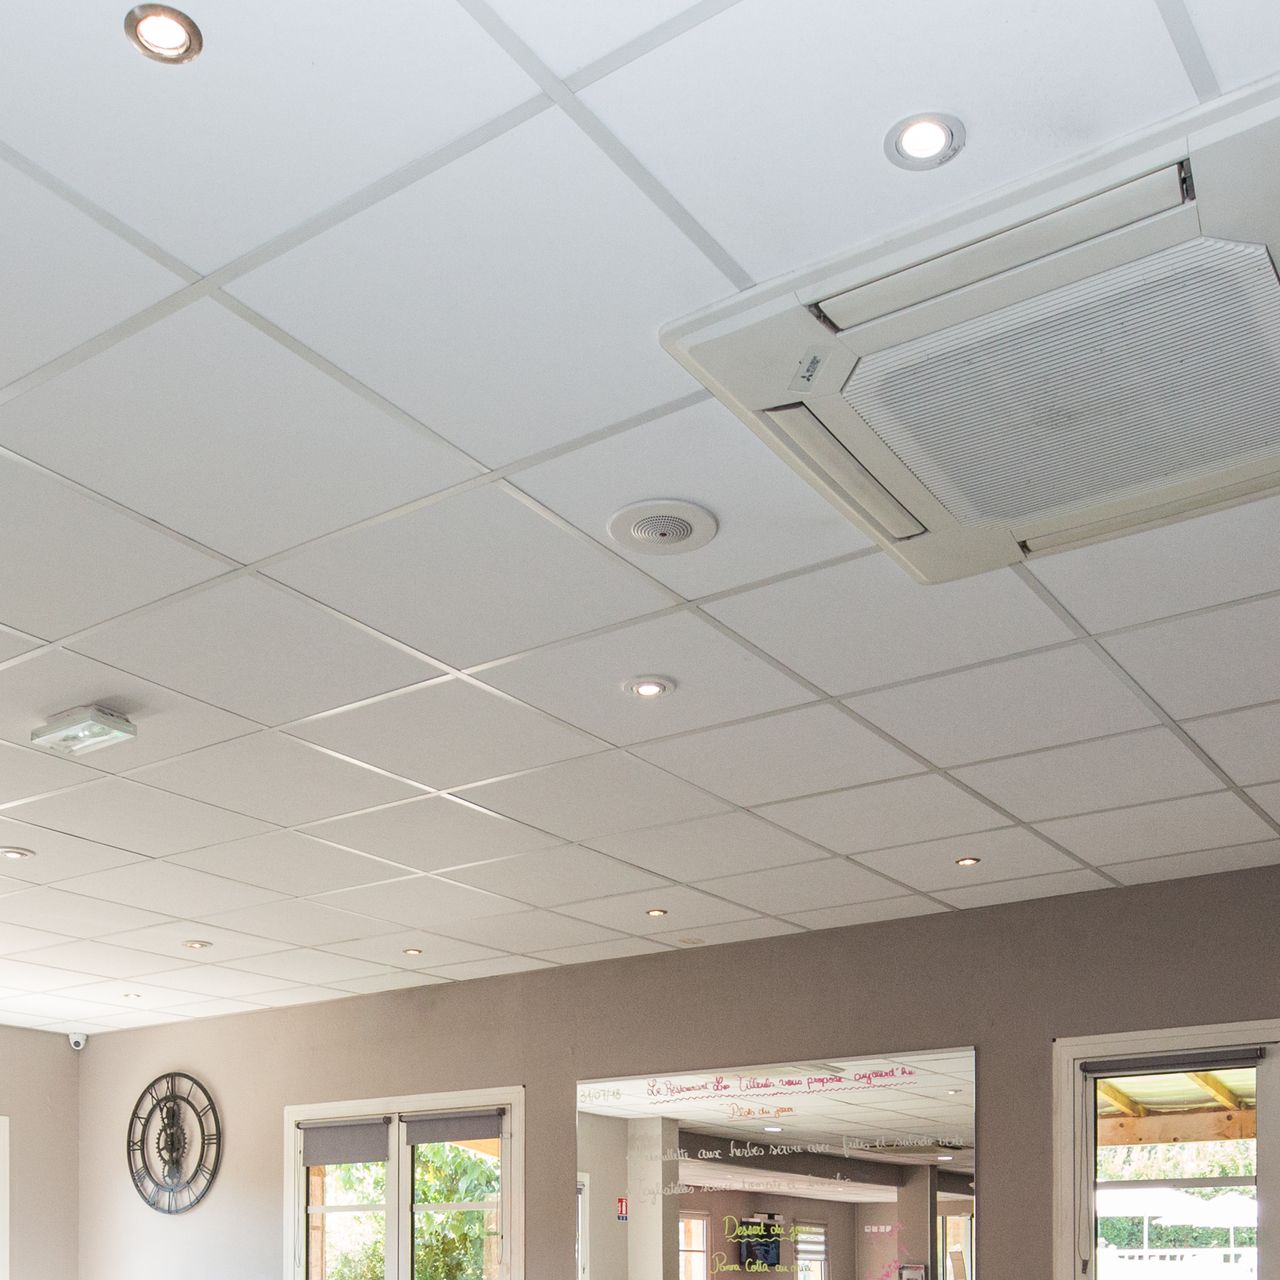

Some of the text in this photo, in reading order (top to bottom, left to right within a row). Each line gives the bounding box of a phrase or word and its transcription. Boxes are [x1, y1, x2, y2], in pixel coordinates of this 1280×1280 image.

[647, 1079, 663, 1096] Le
[698, 1149, 722, 1159] aux
[729, 1140, 764, 1157] herbes
[723, 1215, 767, 1238] Dessert
[770, 1223, 785, 1234] du
[745, 1258, 770, 1272] Cotta
